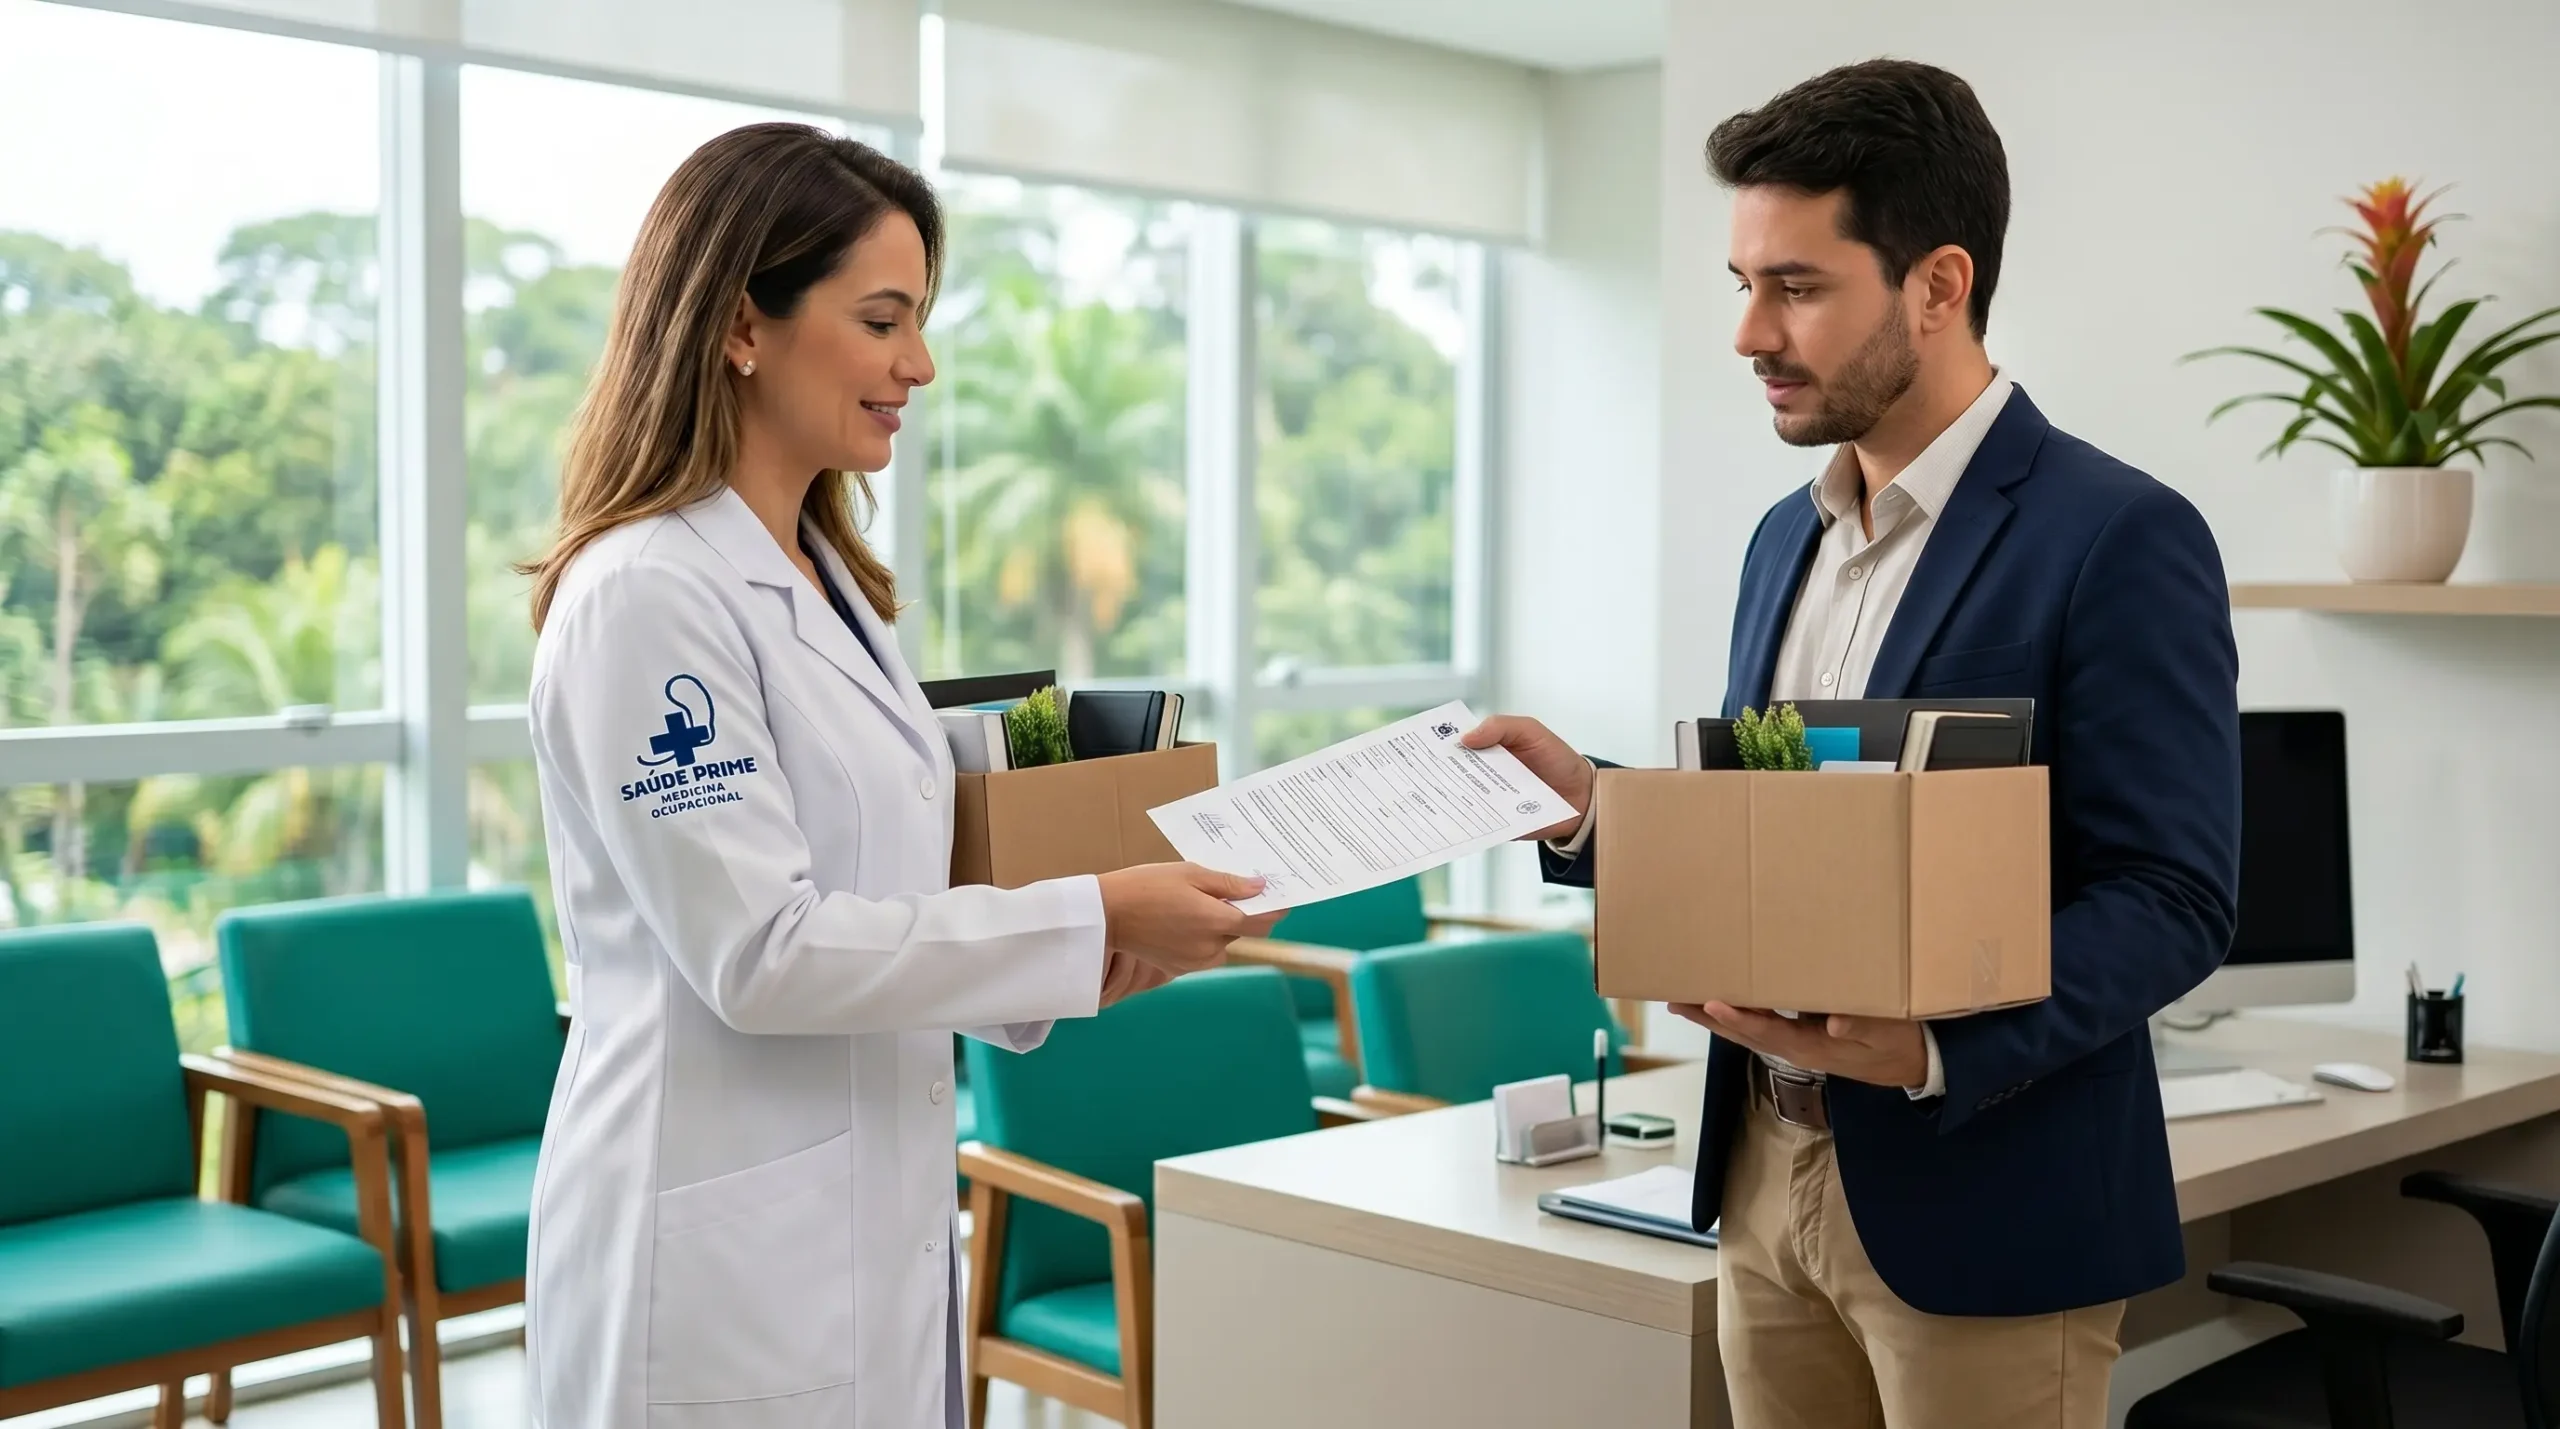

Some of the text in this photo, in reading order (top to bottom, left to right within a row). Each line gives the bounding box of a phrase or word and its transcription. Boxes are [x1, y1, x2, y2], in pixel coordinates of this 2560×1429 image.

[621, 757, 757, 801] SAÚDE PRIME
[651, 791, 743, 818] OCUPACIONAL
[661, 782, 725, 804] MEDICINA
